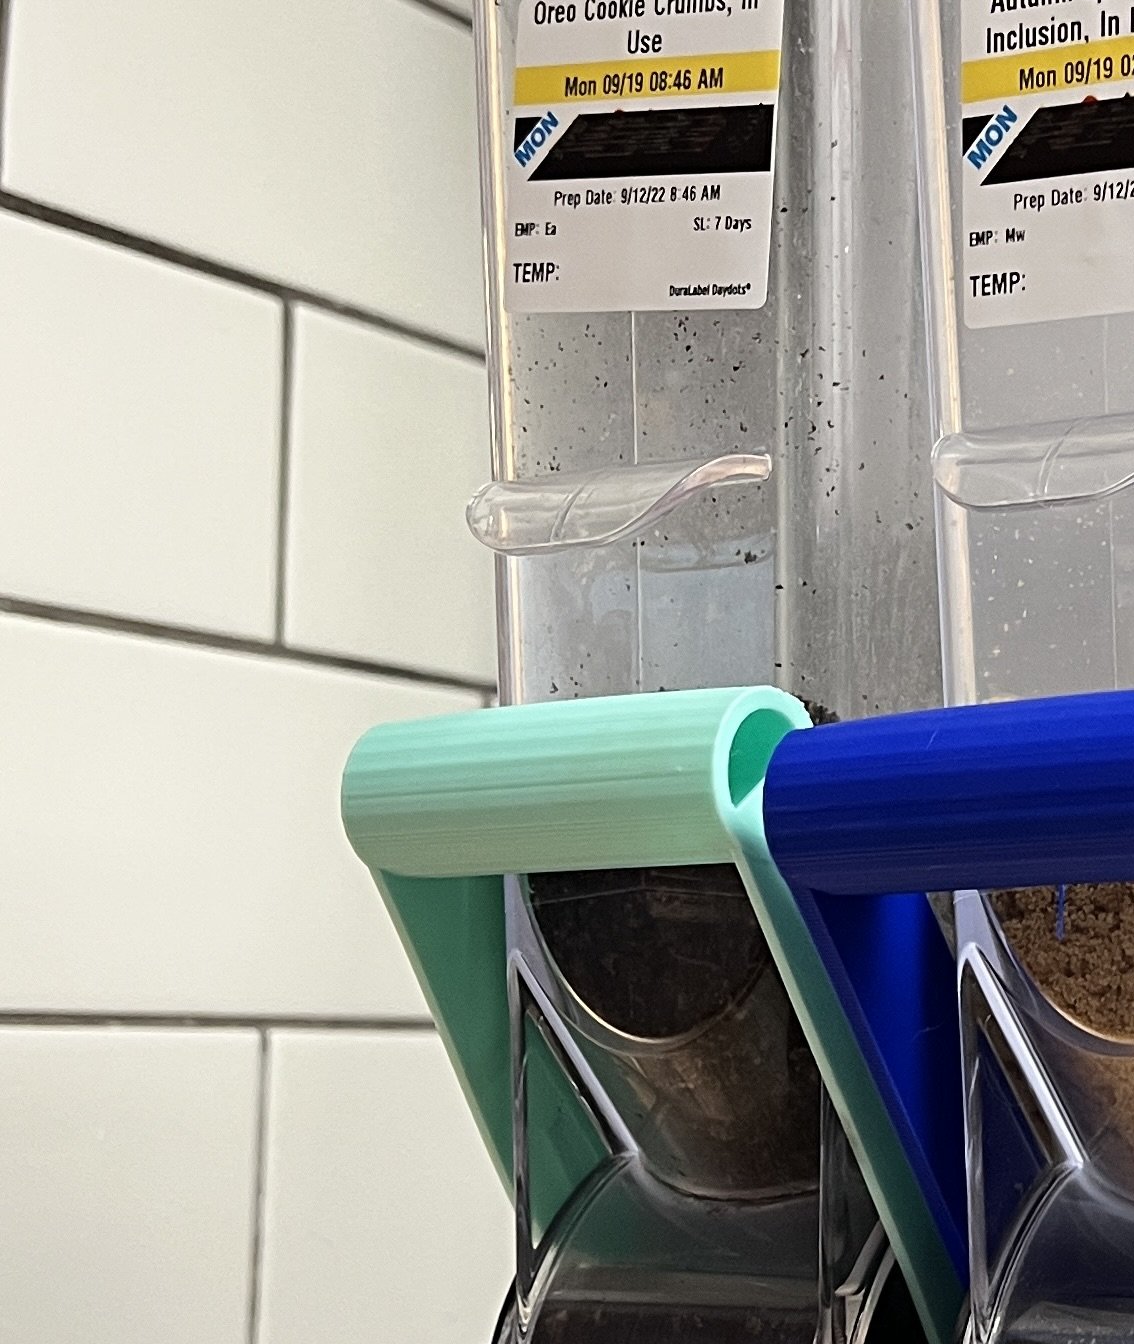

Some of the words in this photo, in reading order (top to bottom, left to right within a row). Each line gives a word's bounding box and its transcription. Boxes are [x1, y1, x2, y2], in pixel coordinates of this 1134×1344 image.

[534, 2, 576, 24] Oreo
[627, 29, 662, 54] Use
[986, 15, 1090, 54] Inclusion,
[1100, 10, 1120, 37] In
[565, 76, 597, 97] Mon
[602, 73, 644, 95] 09/19
[650, 70, 691, 92] 08:46
[698, 68, 724, 90] AM
[1019, 67, 1057, 91] Mon
[1064, 58, 1113, 85] 09/19
[514, 111, 559, 168] MON
[966, 104, 1018, 171] MON
[554, 190, 581, 208] Prep
[586, 189, 617, 205] Date:
[620, 187, 665, 204] 9/12/22
[670, 186, 697, 202] 8:46
[701, 185, 721, 201] AM
[1013, 192, 1045, 213] Prep
[1051, 187, 1088, 208] Date:
[515, 222, 540, 237] EMP:
[545, 222, 557, 236] Ea
[693, 217, 711, 231] SL:
[715, 216, 722, 230] 7
[725, 216, 752, 232] Days
[969, 230, 998, 247] EMP:
[1005, 228, 1026, 244] Mw
[513, 262, 560, 283] TEMP:
[970, 272, 1026, 297] TEMP:
[669, 284, 710, 297] DuraLabel
